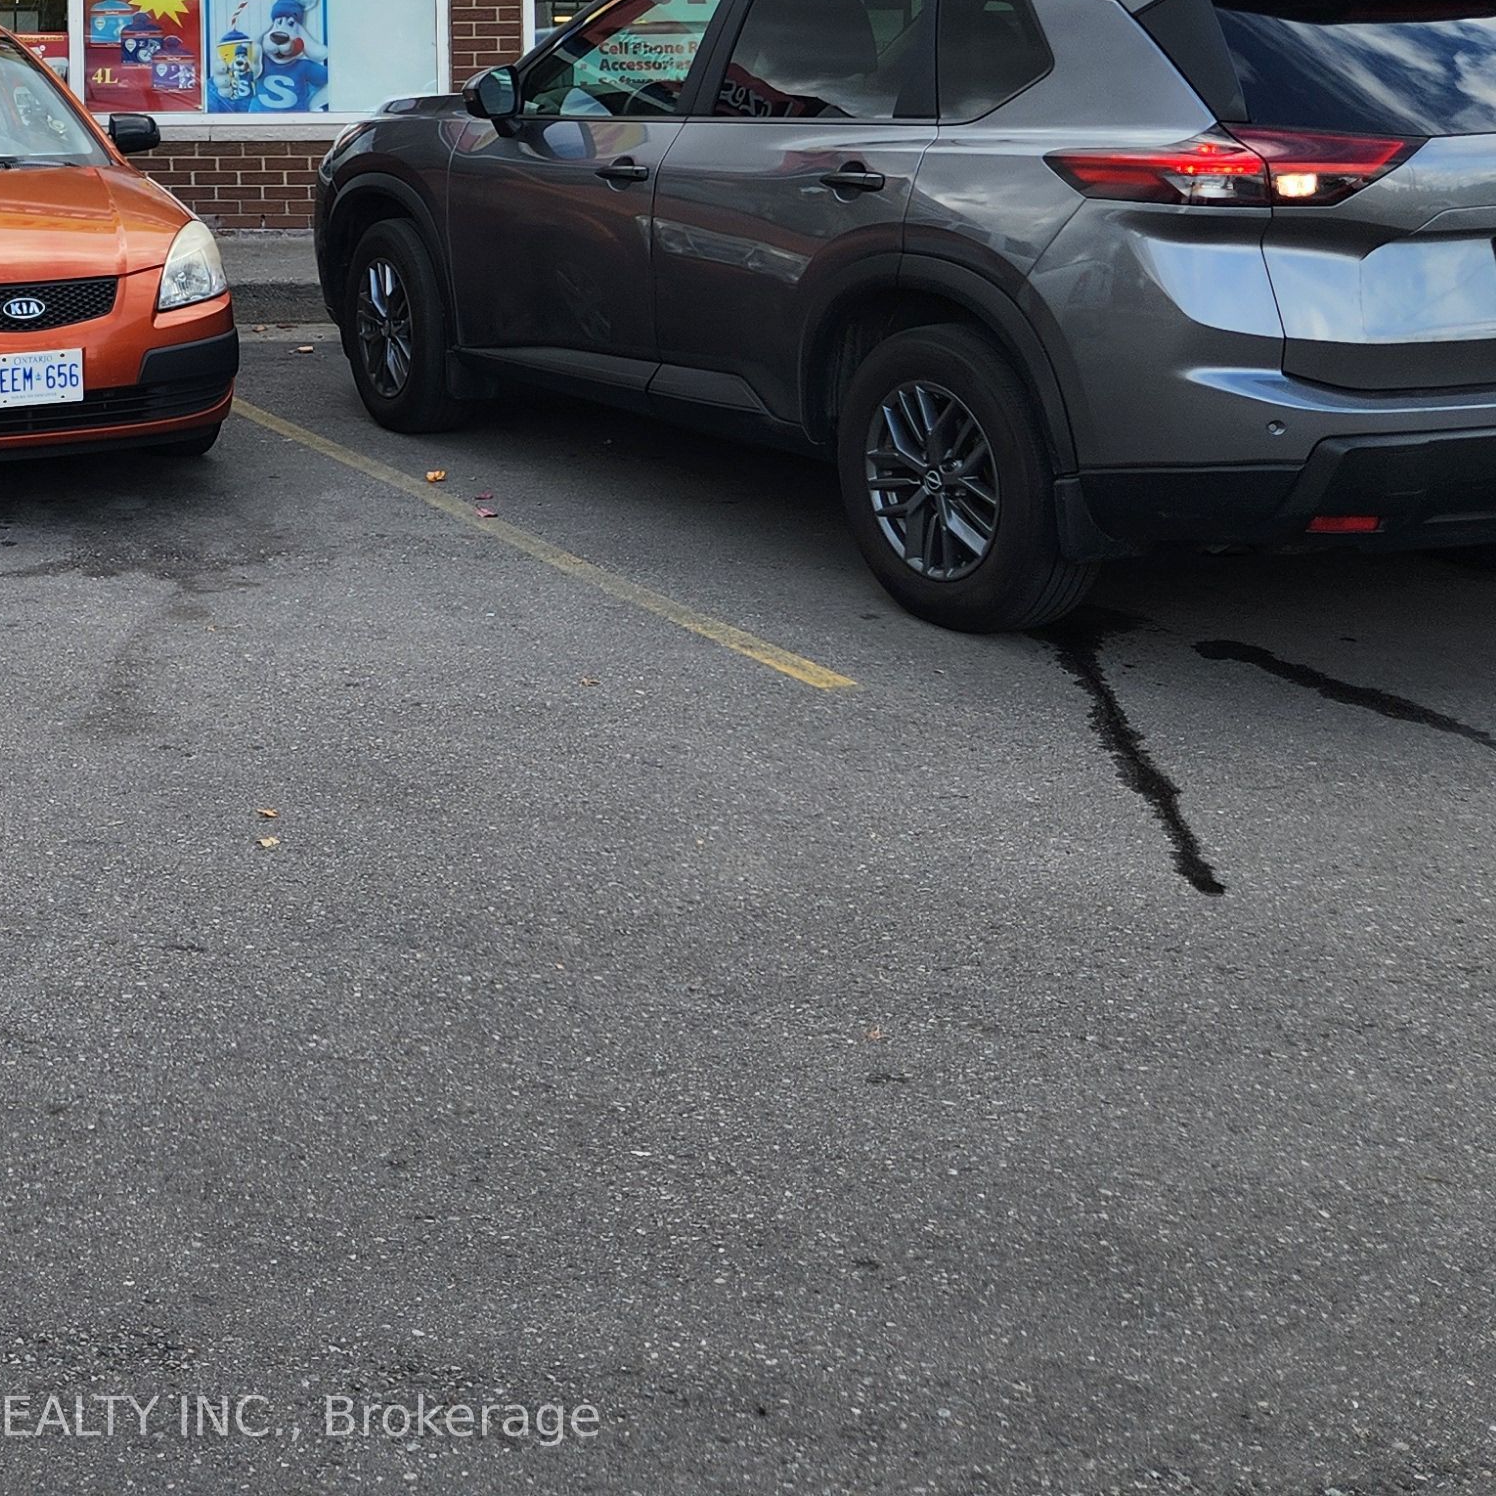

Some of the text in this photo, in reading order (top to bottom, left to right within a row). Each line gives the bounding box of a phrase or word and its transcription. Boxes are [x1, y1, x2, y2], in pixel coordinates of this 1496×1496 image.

[599, 41, 629, 55] Cell
[632, 41, 684, 55] Phone
[91, 67, 118, 85] 4L
[10, 301, 40, 315] KIA
[13, 355, 53, 366] ONTARIO
[45, 363, 80, 390] 656
